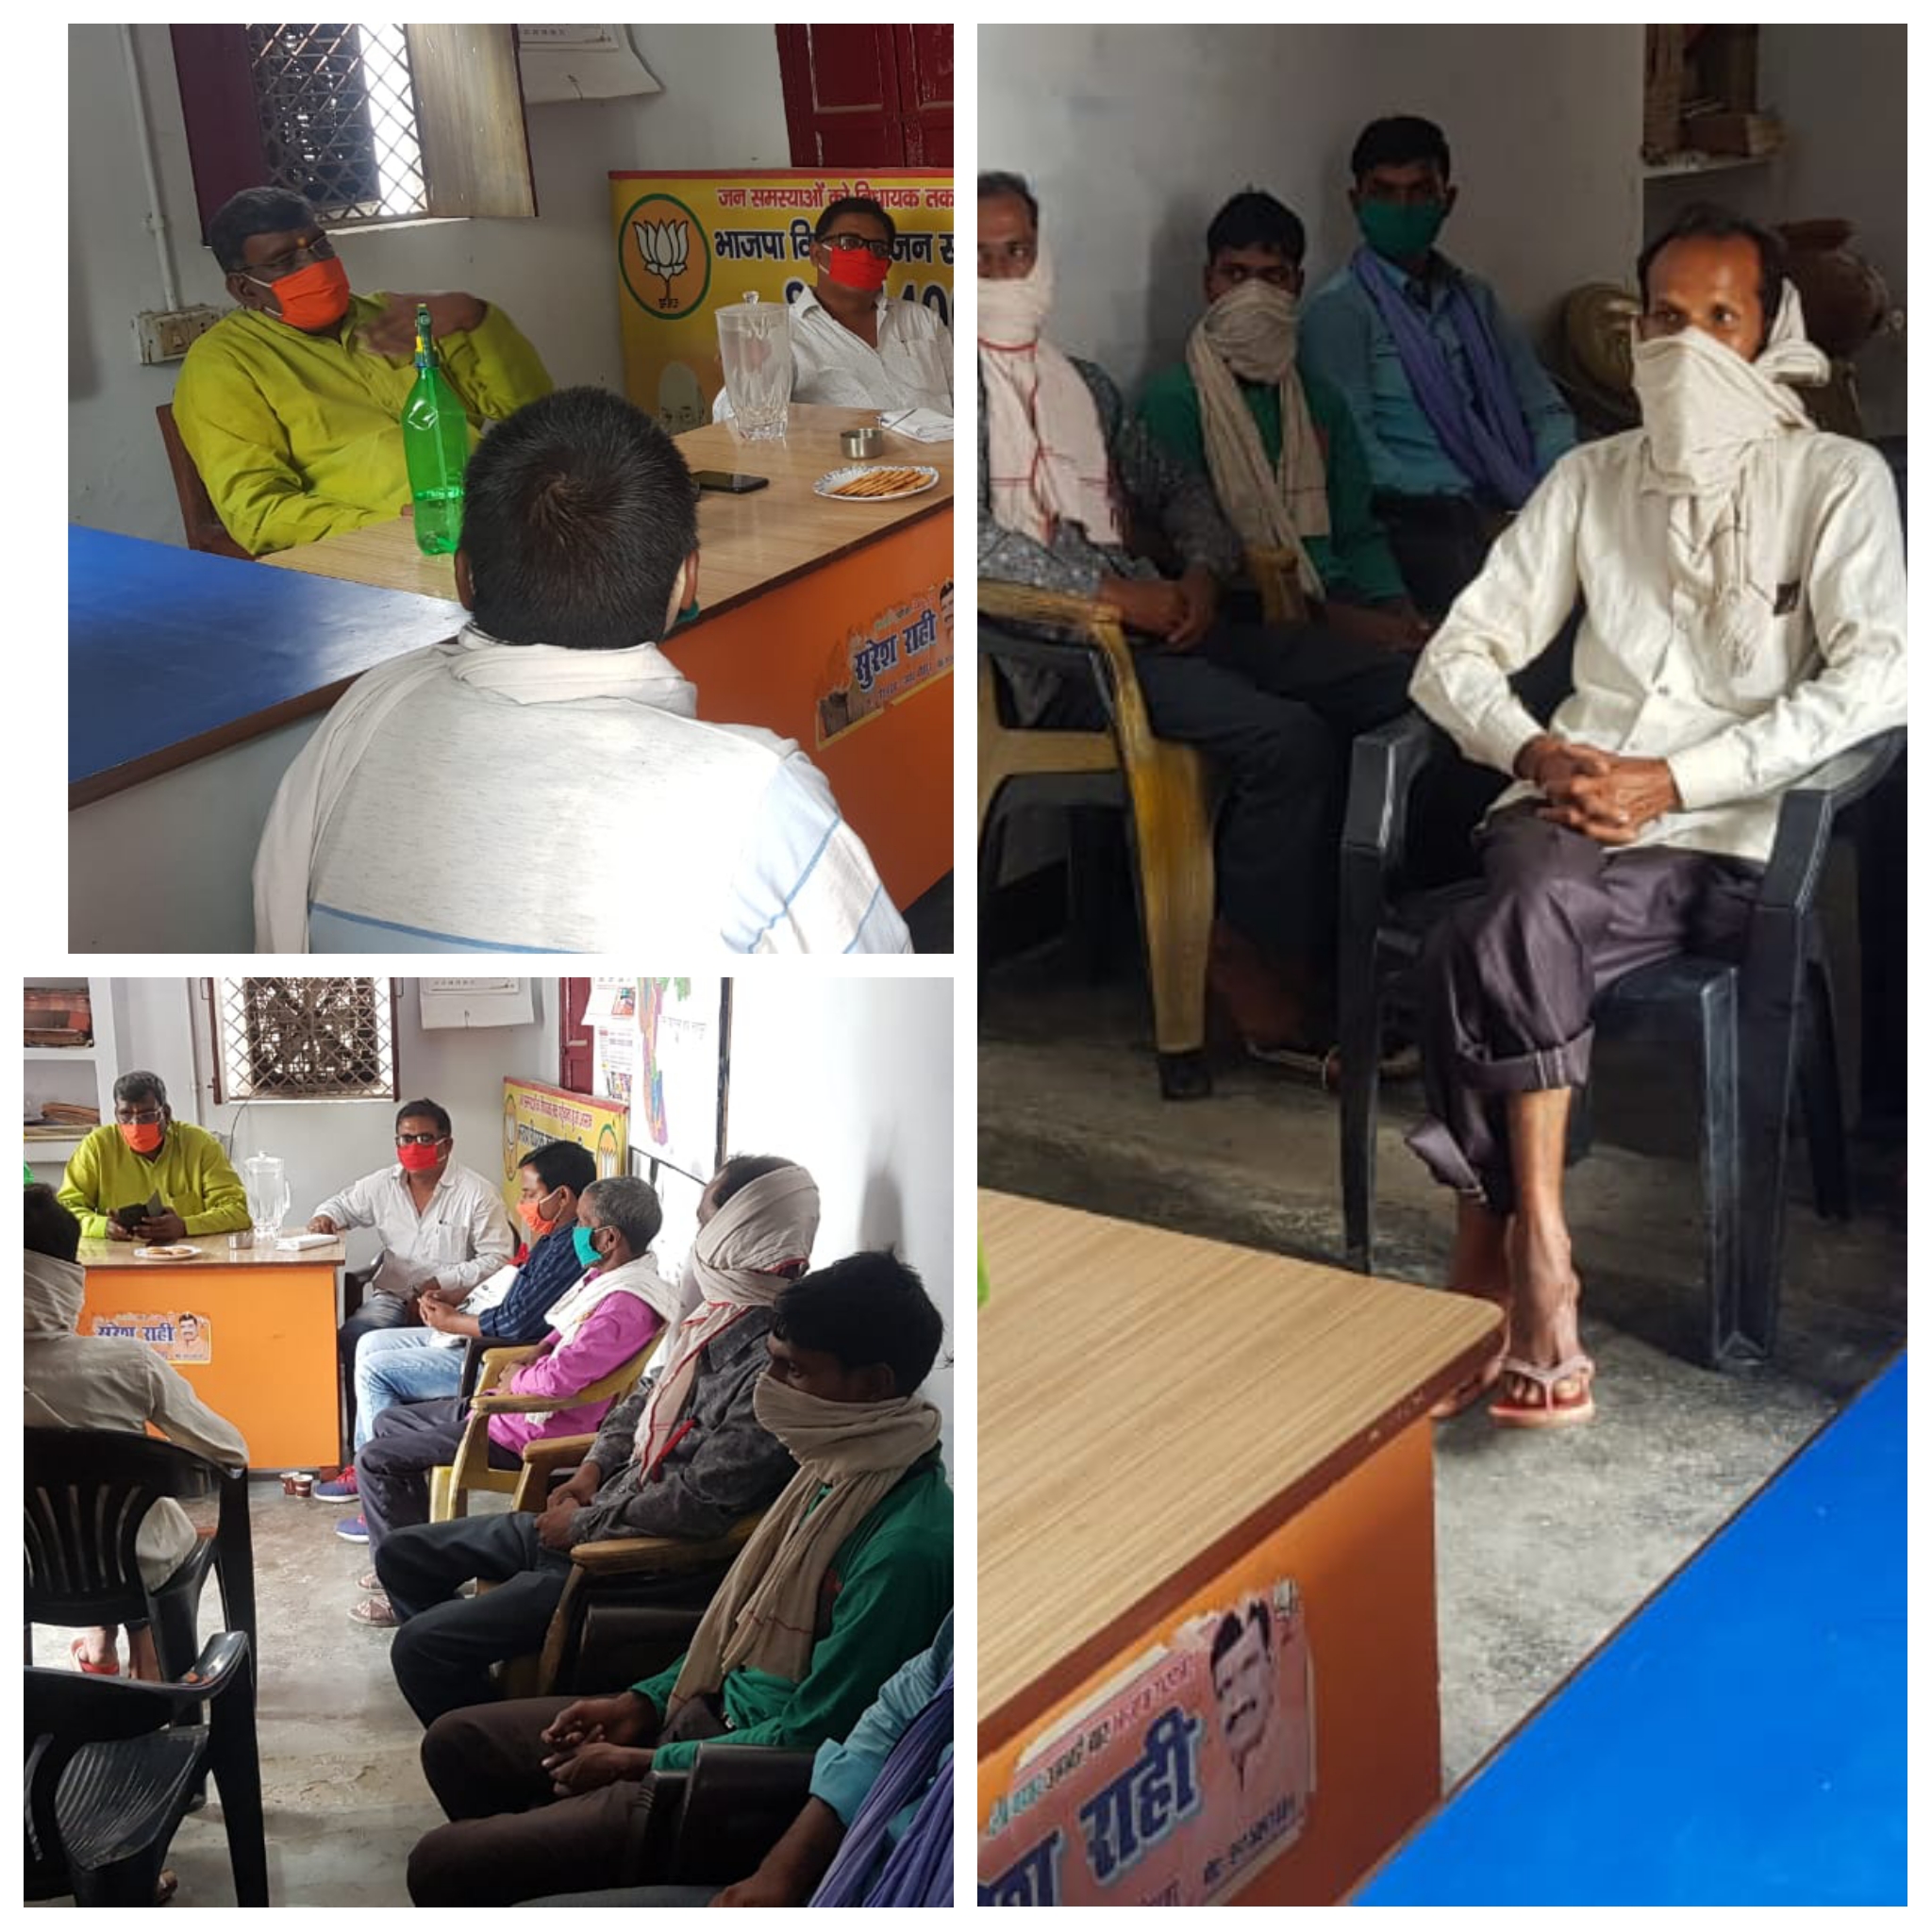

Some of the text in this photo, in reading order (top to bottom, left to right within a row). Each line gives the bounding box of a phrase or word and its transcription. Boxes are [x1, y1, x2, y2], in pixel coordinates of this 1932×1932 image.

[717, 189, 746, 207] जन
[750, 181, 825, 207] समस्याओं
[714, 230, 785, 259] भाजपा
[855, 609, 936, 689] सुरेश राही
[142, 1322, 175, 1341] राही
[1079, 1706, 1198, 1880] राही
